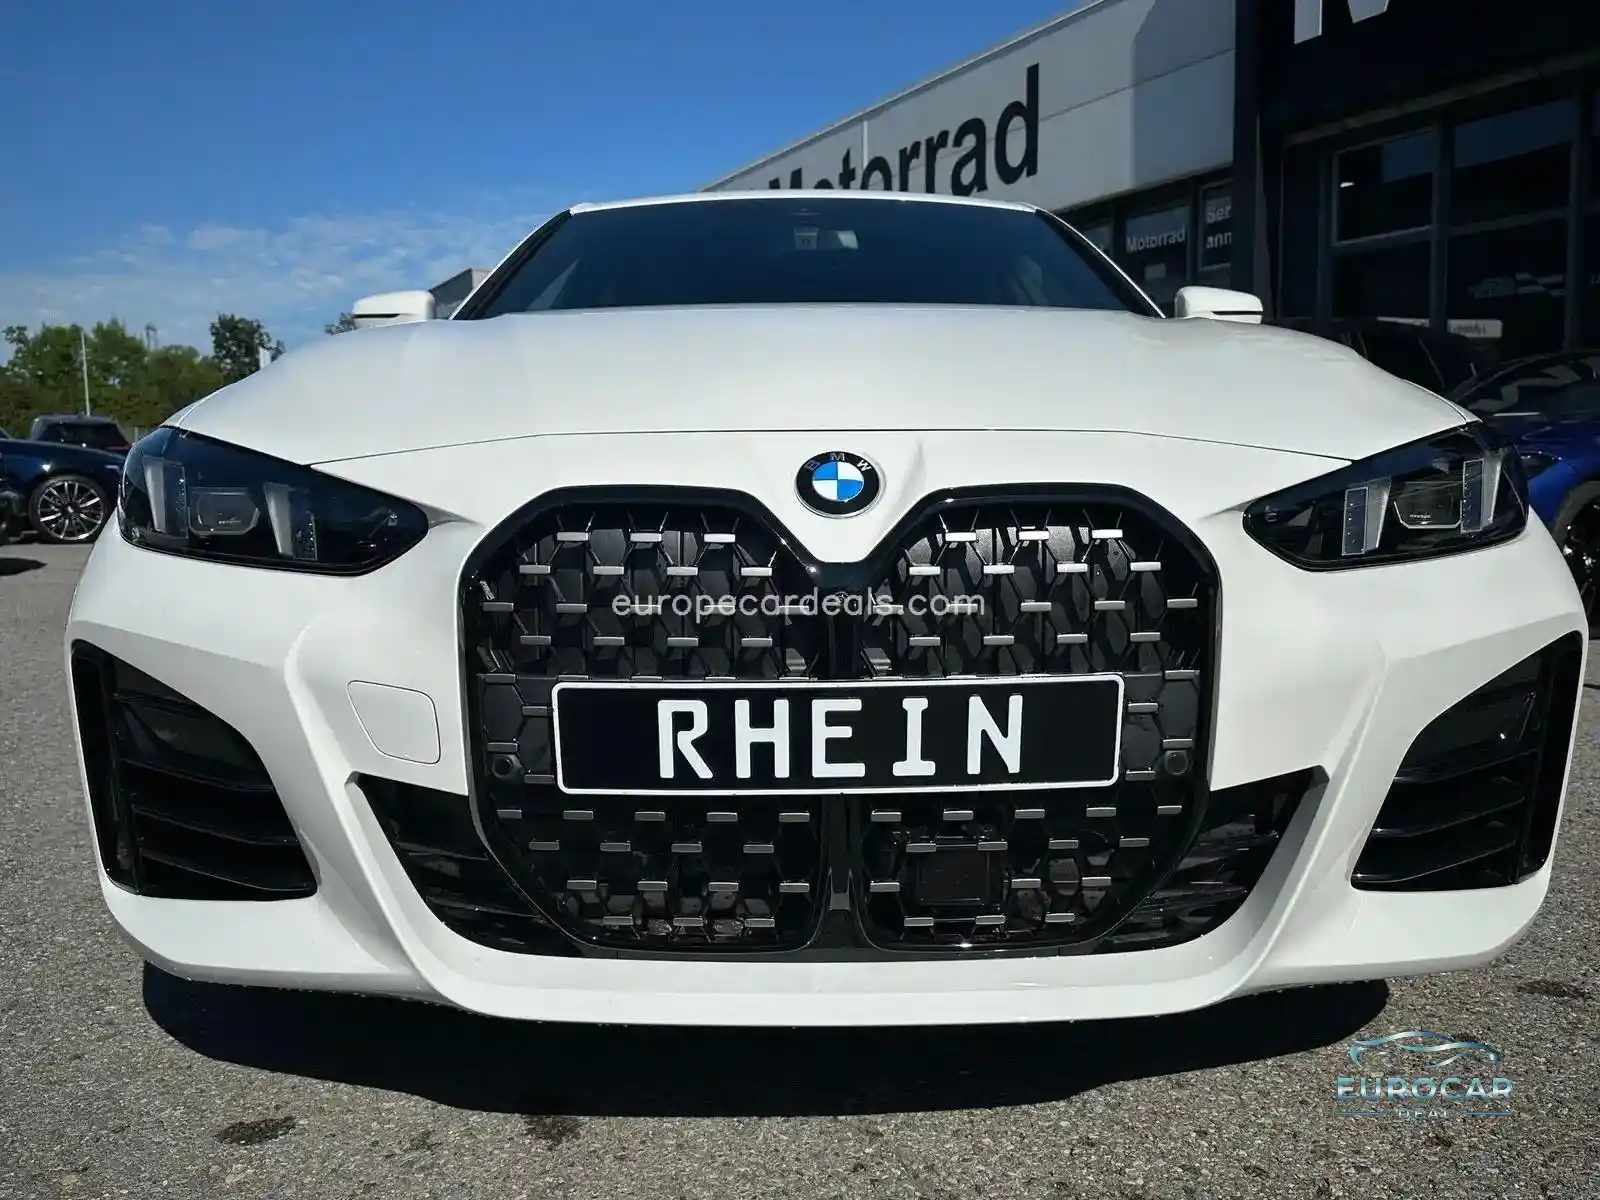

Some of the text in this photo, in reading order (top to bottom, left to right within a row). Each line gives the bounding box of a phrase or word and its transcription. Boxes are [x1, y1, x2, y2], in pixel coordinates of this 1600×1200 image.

[768, 63, 1040, 196] torrad
[1125, 224, 1186, 254] Motorrad
[804, 452, 872, 472] BMW
[656, 694, 1024, 780] RHEIN
